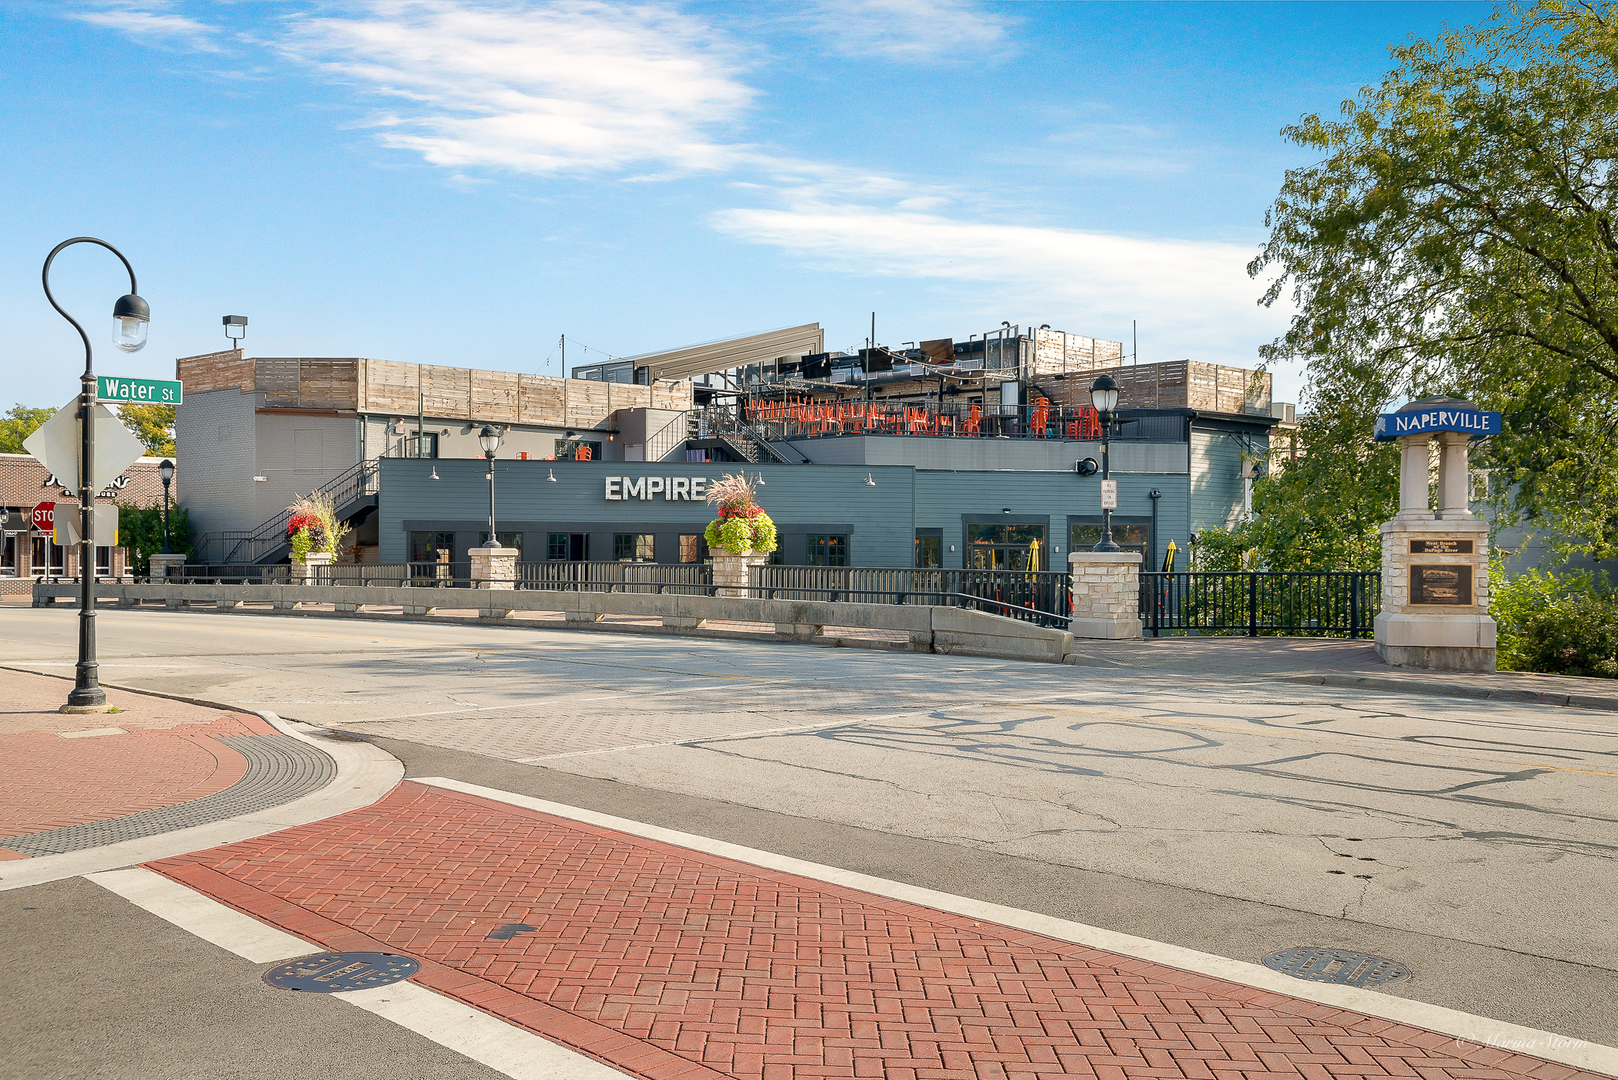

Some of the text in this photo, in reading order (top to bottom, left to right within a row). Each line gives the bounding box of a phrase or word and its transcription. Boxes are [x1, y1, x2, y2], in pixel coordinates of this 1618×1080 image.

[105, 379, 174, 401] Water St
[1396, 411, 1490, 431] NAPERVILLE
[605, 476, 707, 501] EMPIRE
[34, 510, 54, 522] STO
